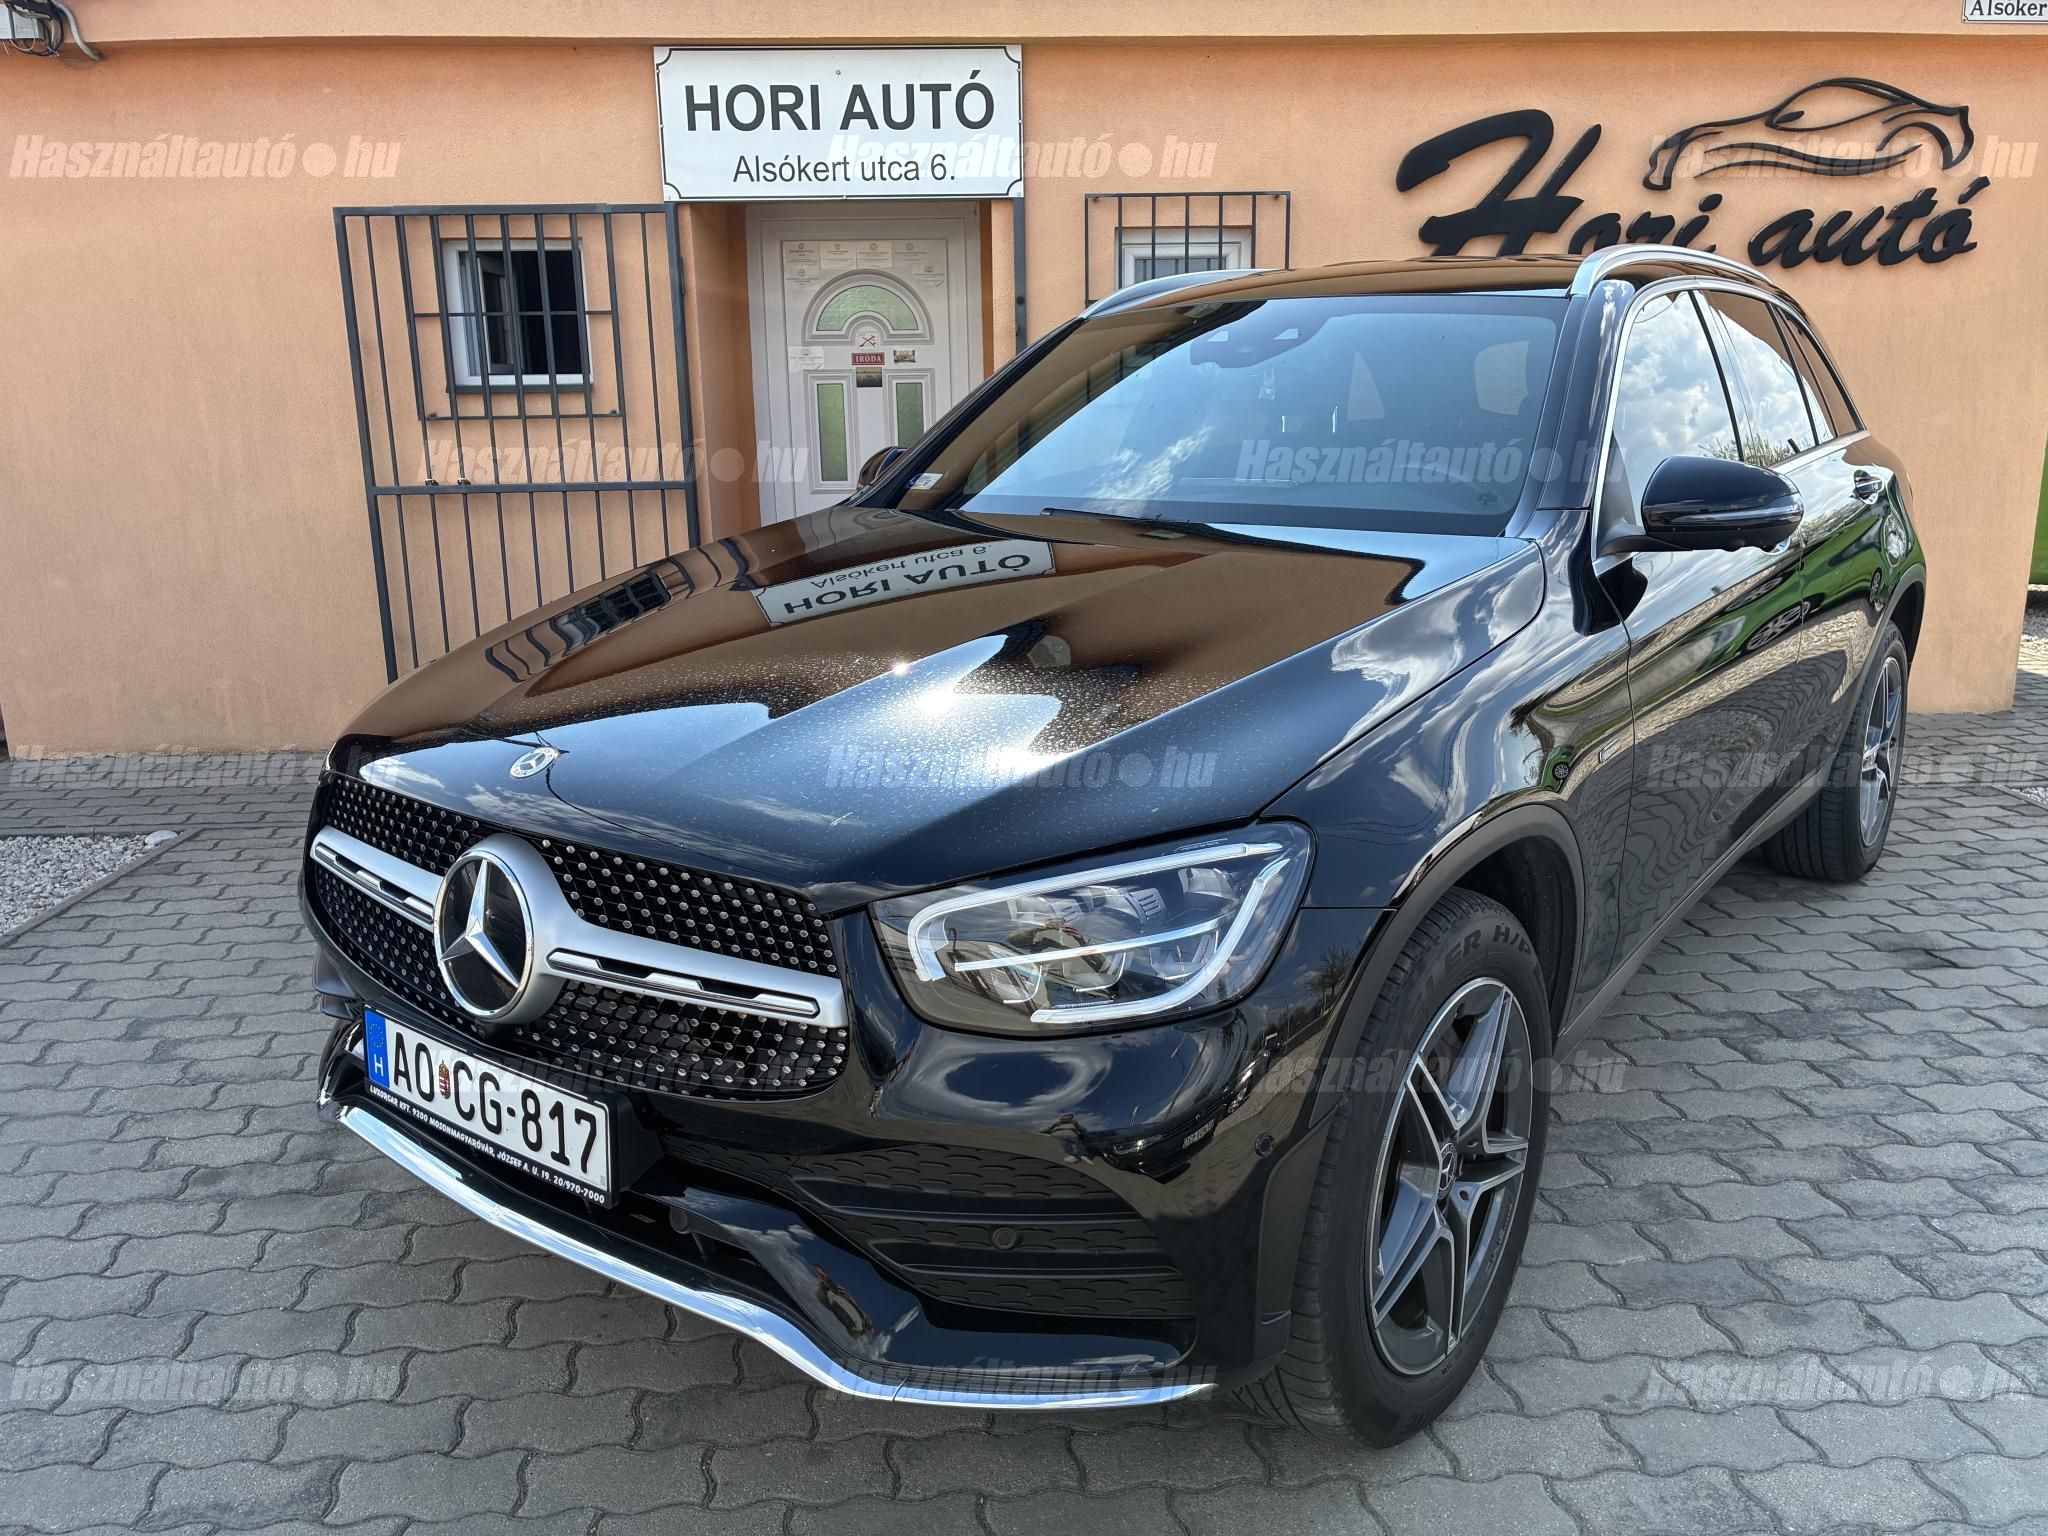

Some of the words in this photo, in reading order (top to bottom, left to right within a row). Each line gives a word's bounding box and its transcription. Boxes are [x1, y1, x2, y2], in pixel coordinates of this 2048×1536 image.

[685, 83, 822, 132] HORI
[839, 69, 995, 131] AUTÓ
[733, 155, 851, 182] Alsókert
[860, 156, 920, 182] utca
[930, 153, 956, 181] 6.
[1748, 176, 1989, 268] autó
[855, 355, 882, 363] IRODA
[373, 1053, 385, 1077] H
[369, 1084, 398, 1108] LUXORCAR
[412, 1108, 429, 1123] 9200
[496, 1150, 522, 1168] JÓZSEF
[522, 1162, 530, 1173] A.
[531, 1165, 540, 1177] U.
[541, 1169, 552, 1182] 19.
[553, 1175, 606, 1204] 20/970-7000
[453, 1060, 597, 1174] CG-817
